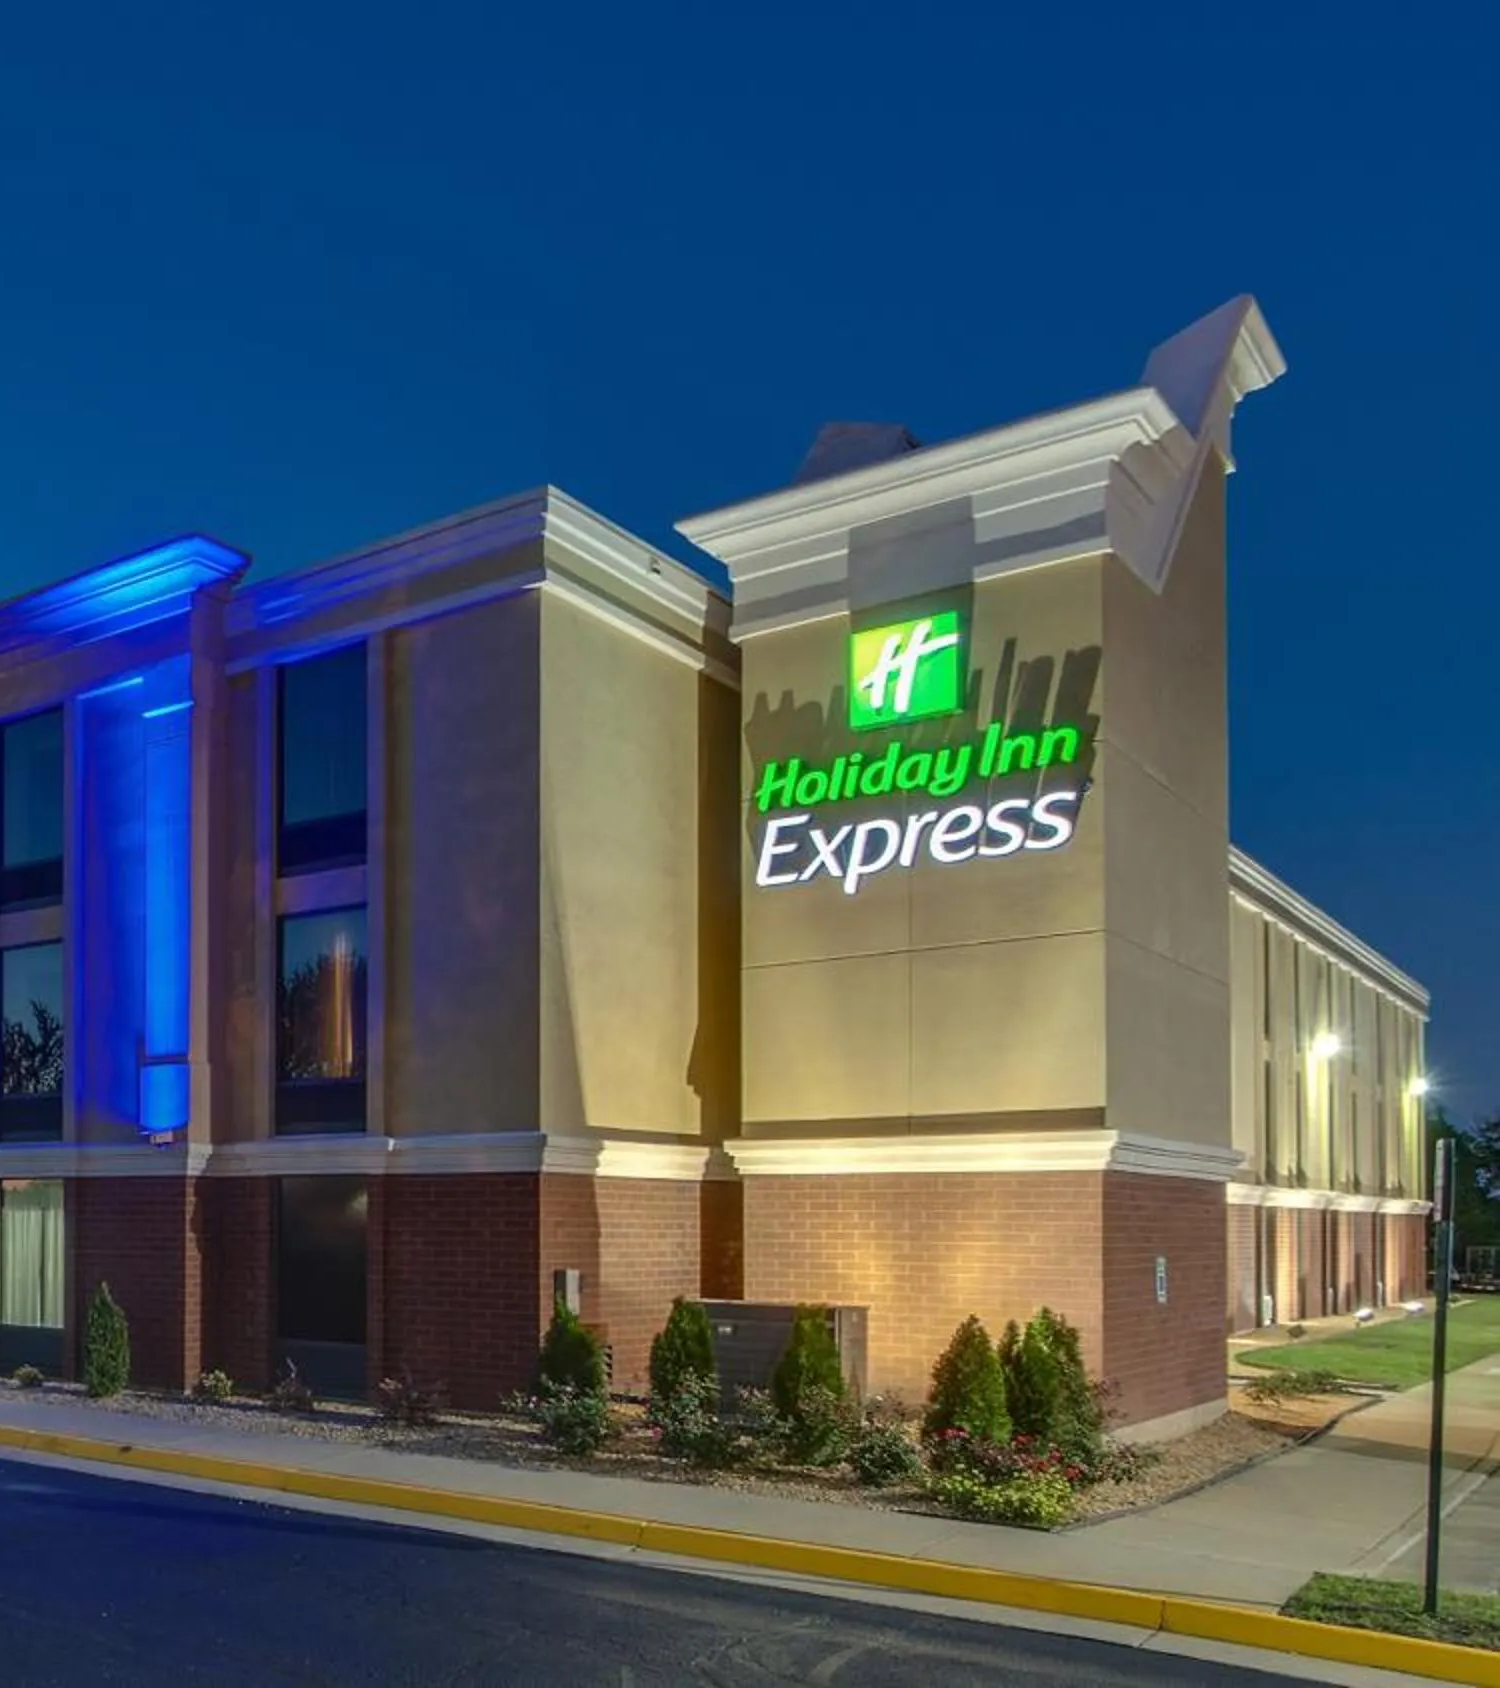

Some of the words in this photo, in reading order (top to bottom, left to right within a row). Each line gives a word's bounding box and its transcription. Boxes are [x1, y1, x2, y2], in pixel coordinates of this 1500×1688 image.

[757, 742, 971, 811] Holiday
[979, 722, 1079, 776] Inn
[756, 791, 1078, 894] Express
